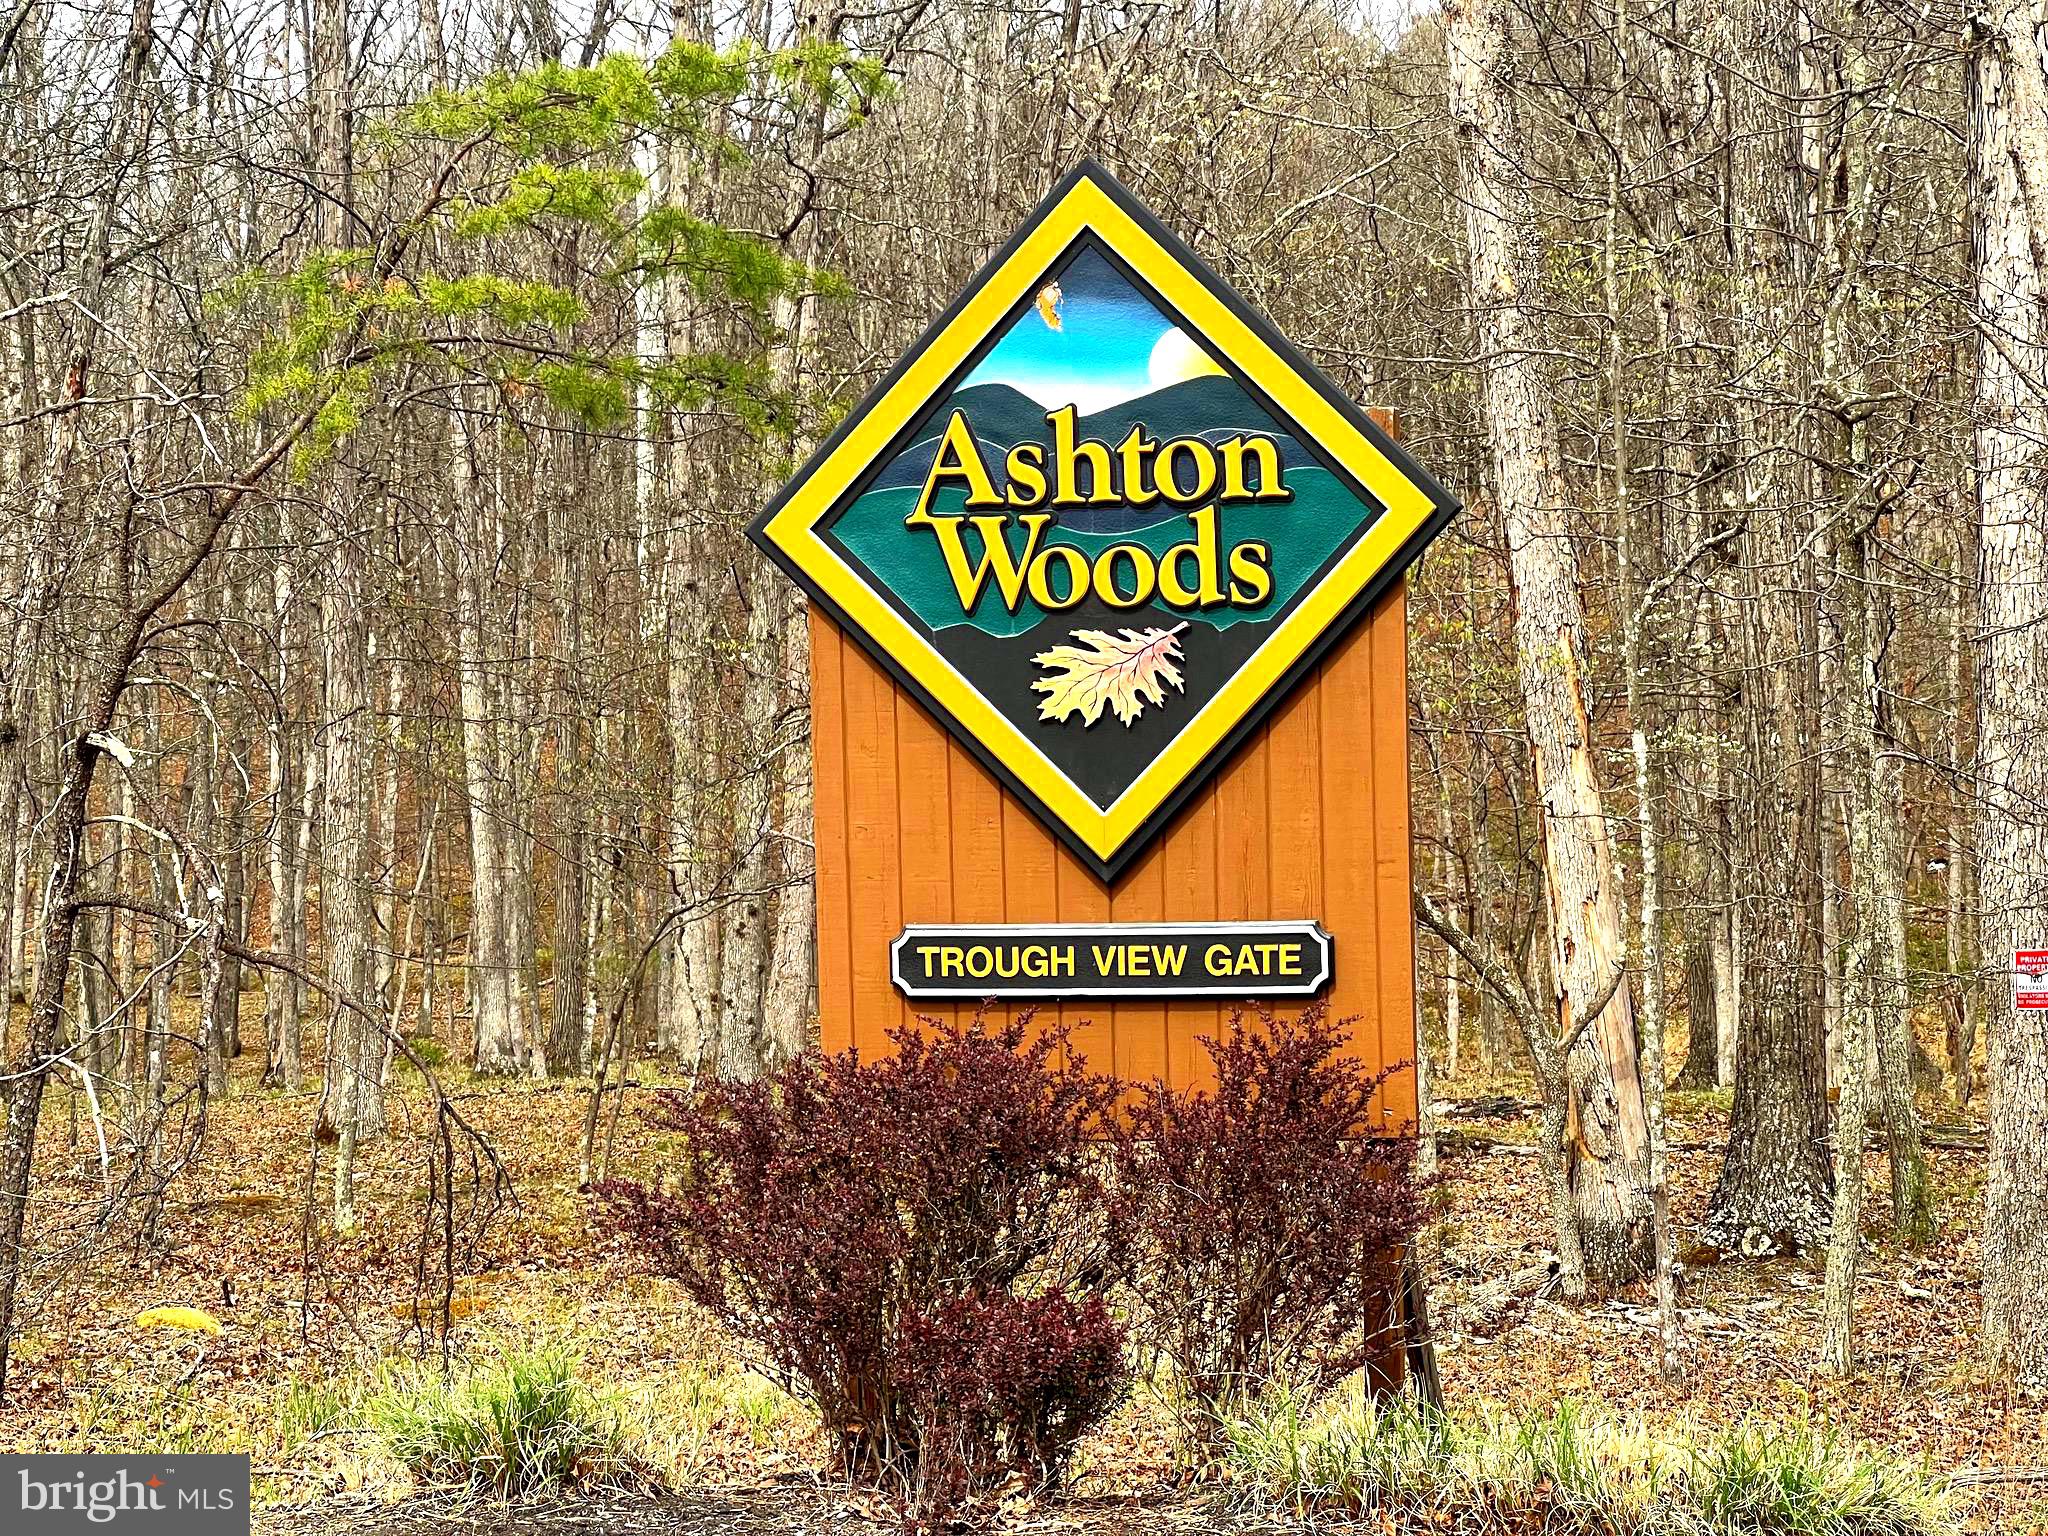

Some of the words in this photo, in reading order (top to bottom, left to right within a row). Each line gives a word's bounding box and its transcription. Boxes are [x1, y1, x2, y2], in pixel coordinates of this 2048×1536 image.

[905, 403, 1293, 526] Ashton
[930, 504, 1272, 613] Woods
[916, 945, 1075, 978] TROUGH
[1092, 944, 1188, 977] VIEW
[1204, 943, 1303, 977] GATE
[2030, 974, 2042, 983] NO
